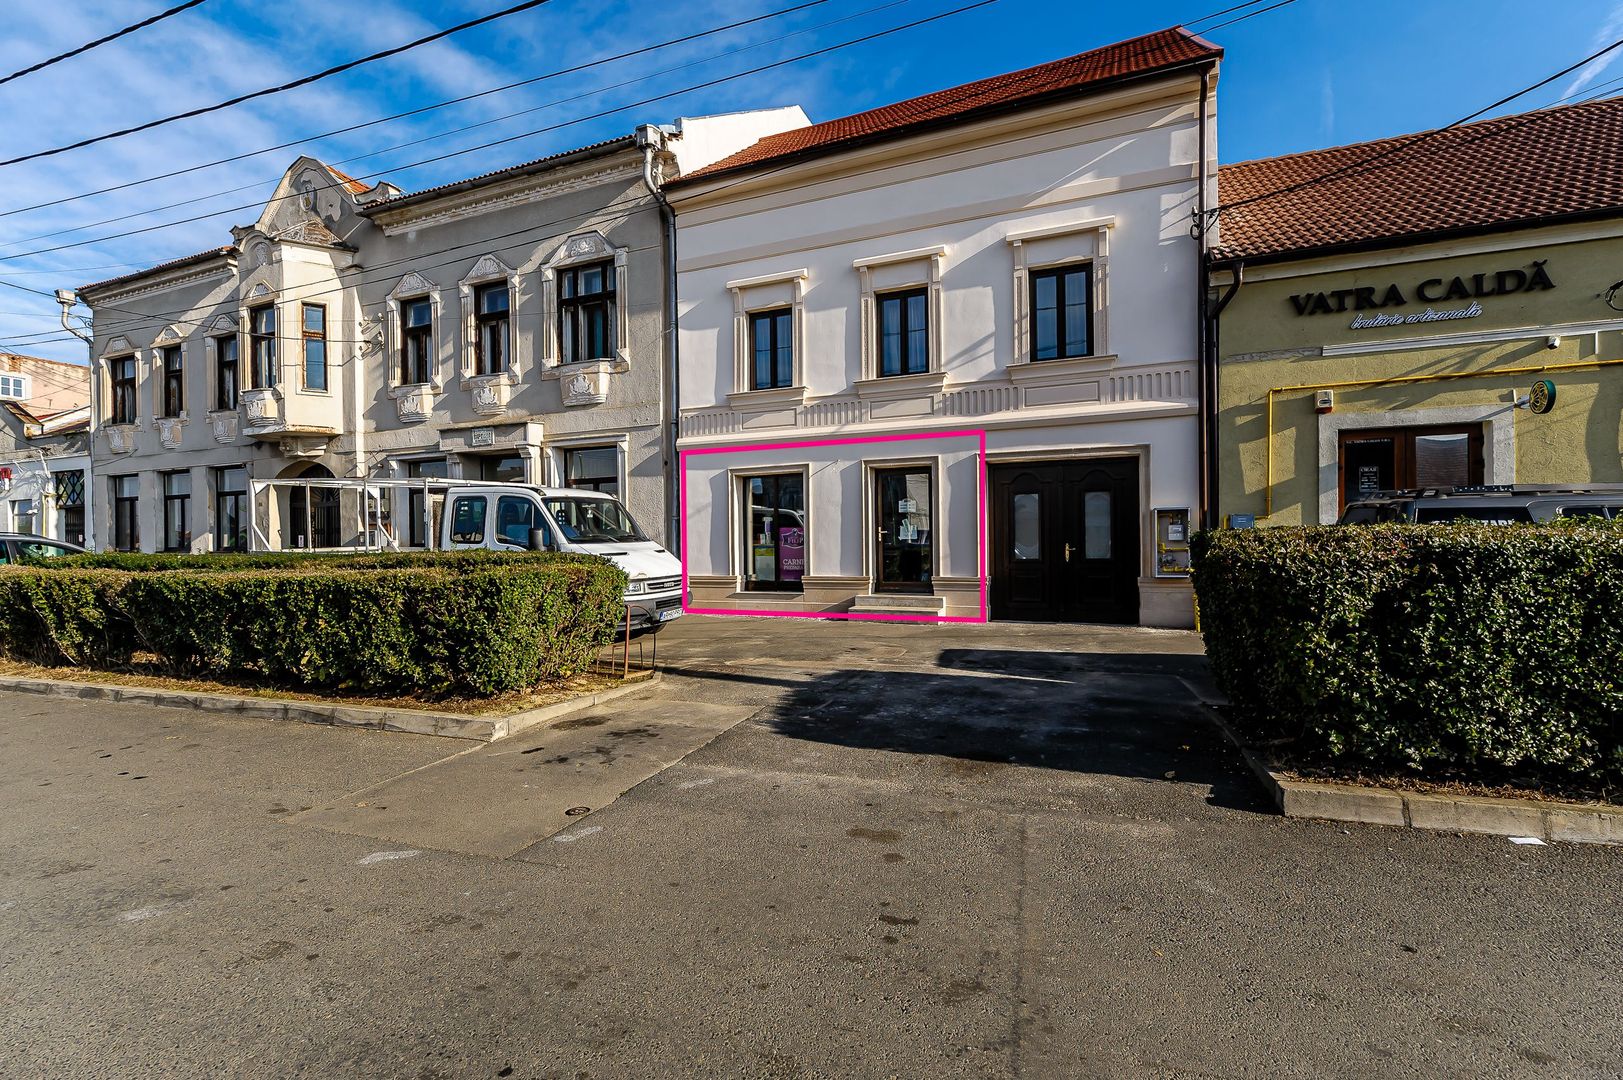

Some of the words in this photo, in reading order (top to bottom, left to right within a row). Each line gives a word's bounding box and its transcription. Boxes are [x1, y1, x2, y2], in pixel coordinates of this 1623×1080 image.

[1289, 283, 1407, 316] VATRA
[1416, 259, 1557, 303] CALDĂ
[1350, 312, 1404, 330] brutărie
[1405, 301, 1483, 324] artizanală
